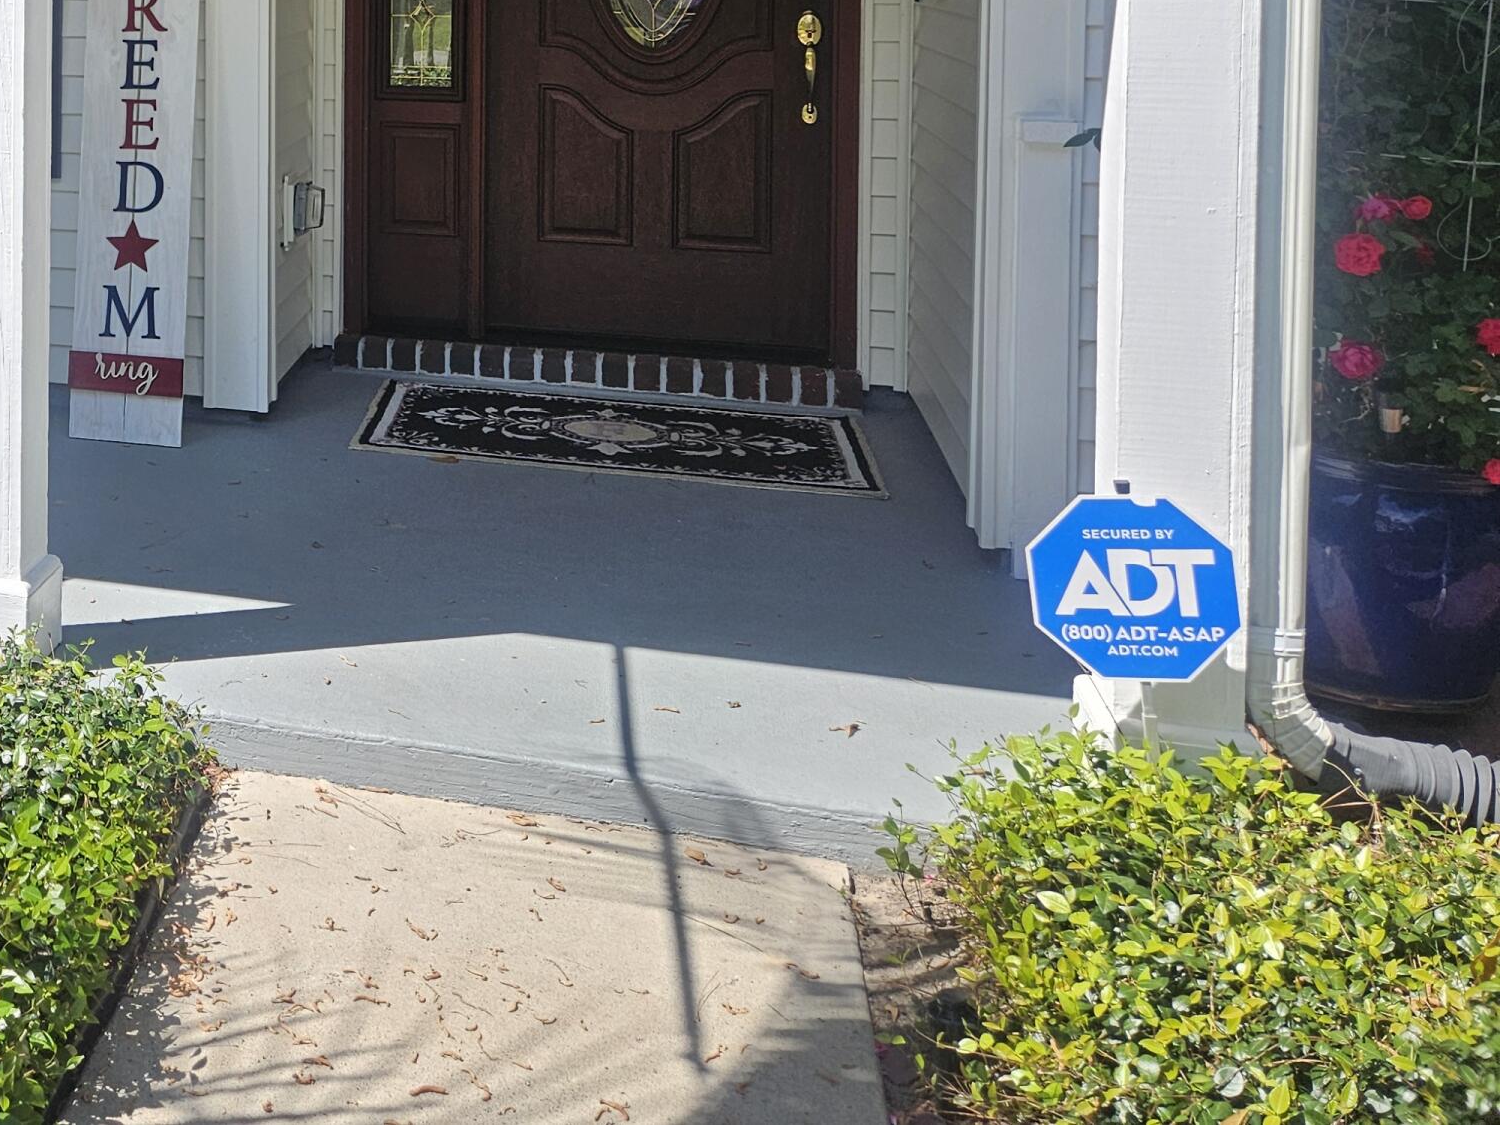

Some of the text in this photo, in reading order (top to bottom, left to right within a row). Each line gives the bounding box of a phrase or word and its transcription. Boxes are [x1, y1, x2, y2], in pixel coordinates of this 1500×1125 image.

[94, 352, 159, 395] ring
[1082, 528, 1175, 540] SECURED BY
[1055, 548, 1216, 617] ADT
[1061, 623, 1226, 643] (800) ADT-ASAP
[1107, 644, 1179, 657] ADT.COM
